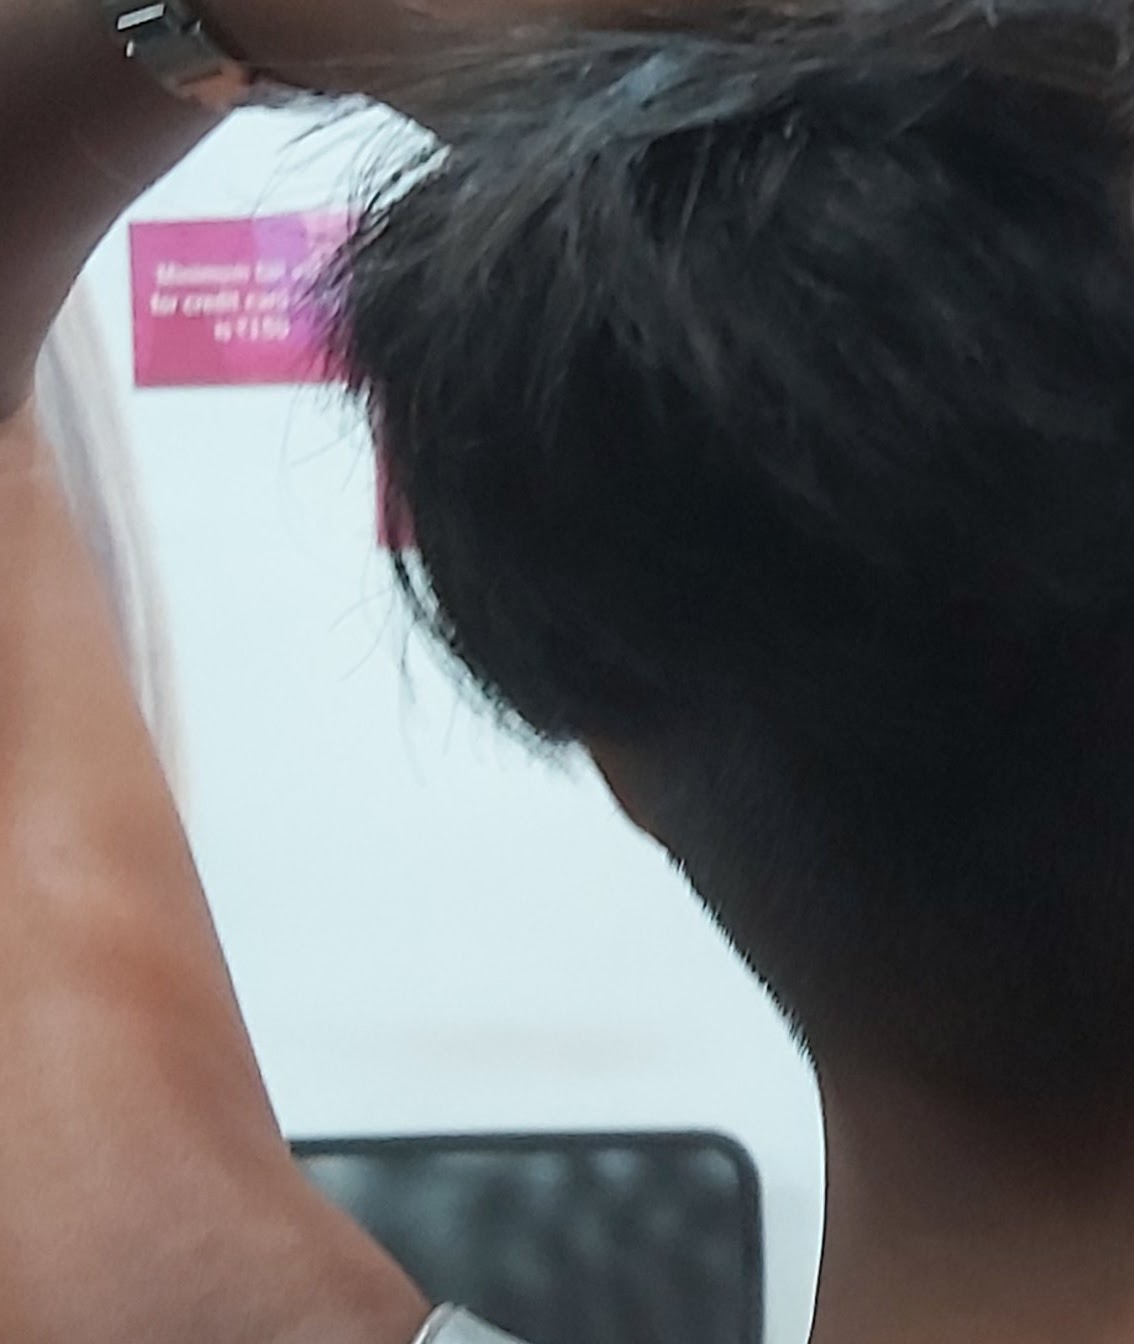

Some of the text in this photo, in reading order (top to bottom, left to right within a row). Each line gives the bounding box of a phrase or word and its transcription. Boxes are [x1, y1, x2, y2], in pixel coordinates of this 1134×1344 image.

[155, 261, 251, 286] Minimum
[150, 290, 178, 317] for
[182, 289, 240, 317] credit
